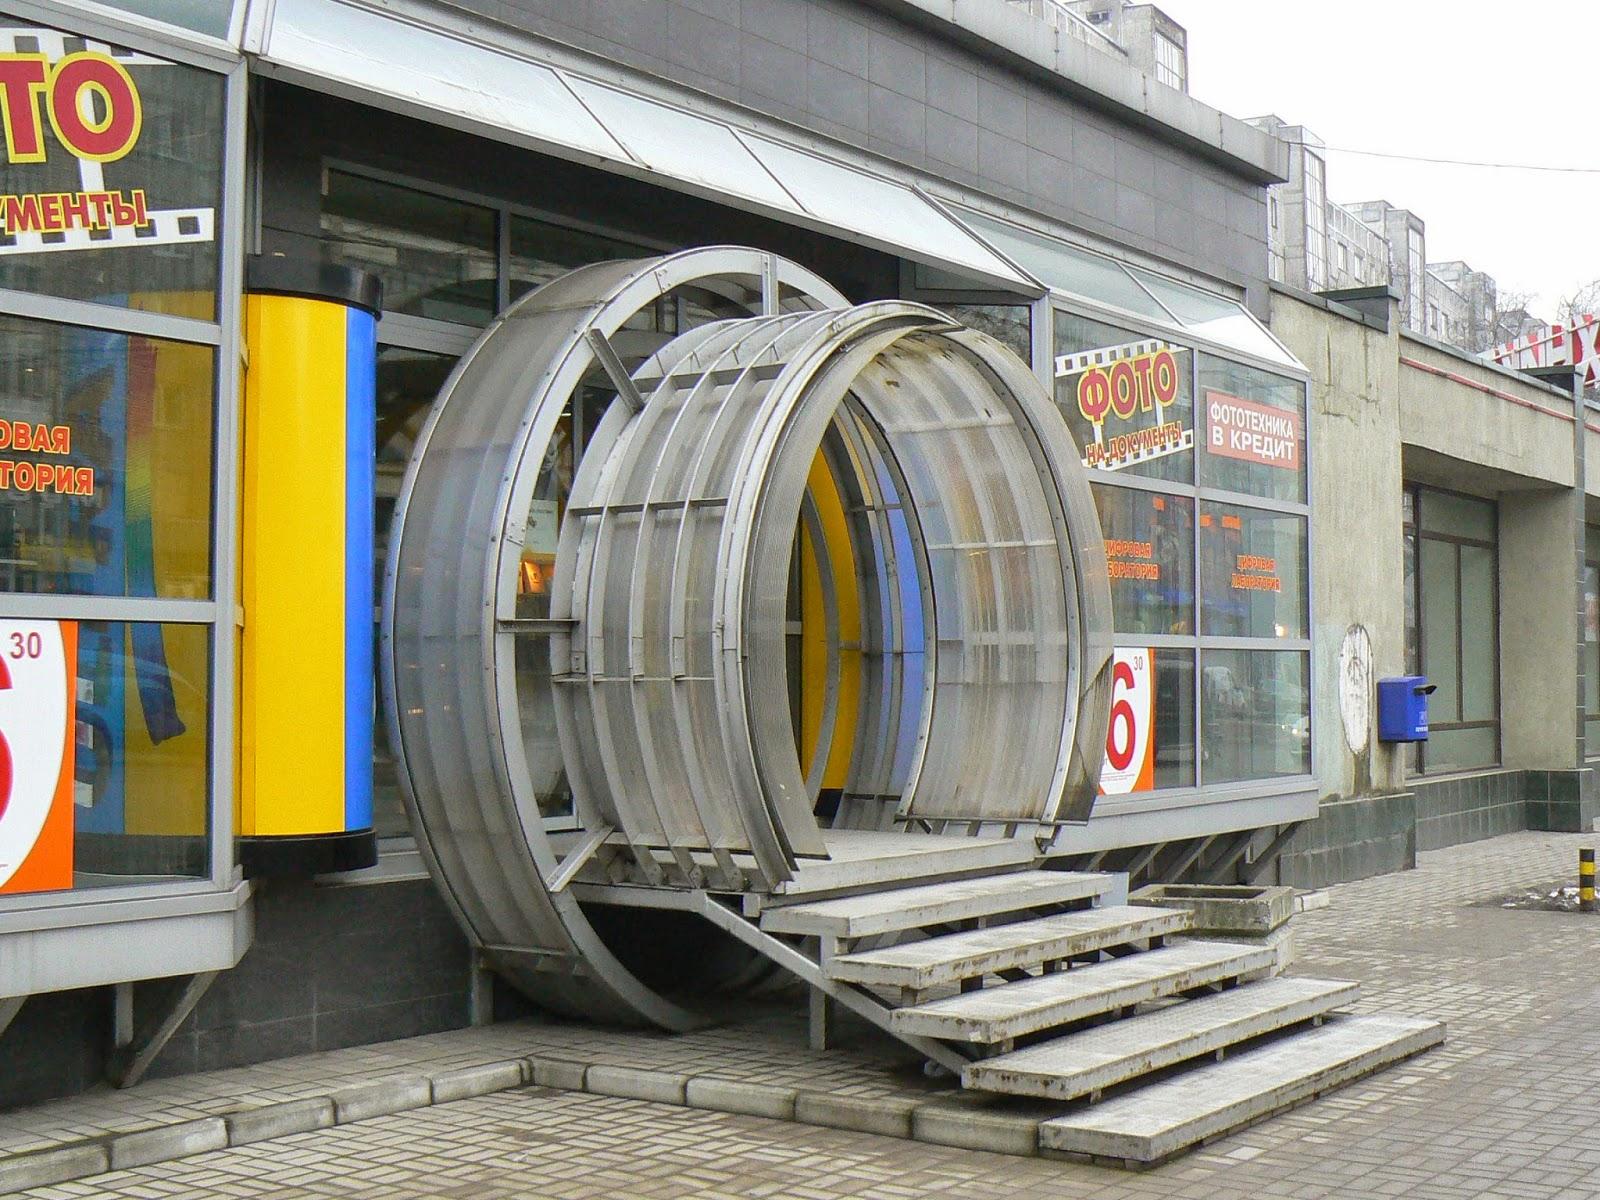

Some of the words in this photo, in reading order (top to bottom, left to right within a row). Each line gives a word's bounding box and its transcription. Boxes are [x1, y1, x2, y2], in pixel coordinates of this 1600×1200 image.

[0, 189, 148, 235] МЕНТЫ
[1077, 348, 1178, 426] ФОТО
[1210, 400, 1294, 439] ФОТОТЕХНИКА
[1085, 443, 1105, 467] НА
[1105, 421, 1183, 465] ДОКУМЕНТЫ
[1212, 425, 1223, 446] В
[1230, 429, 1295, 461] КРЕДИТ
[10, 631, 42, 659] 30
[1106, 661, 1136, 771] 6
[1133, 656, 1143, 671] 30
